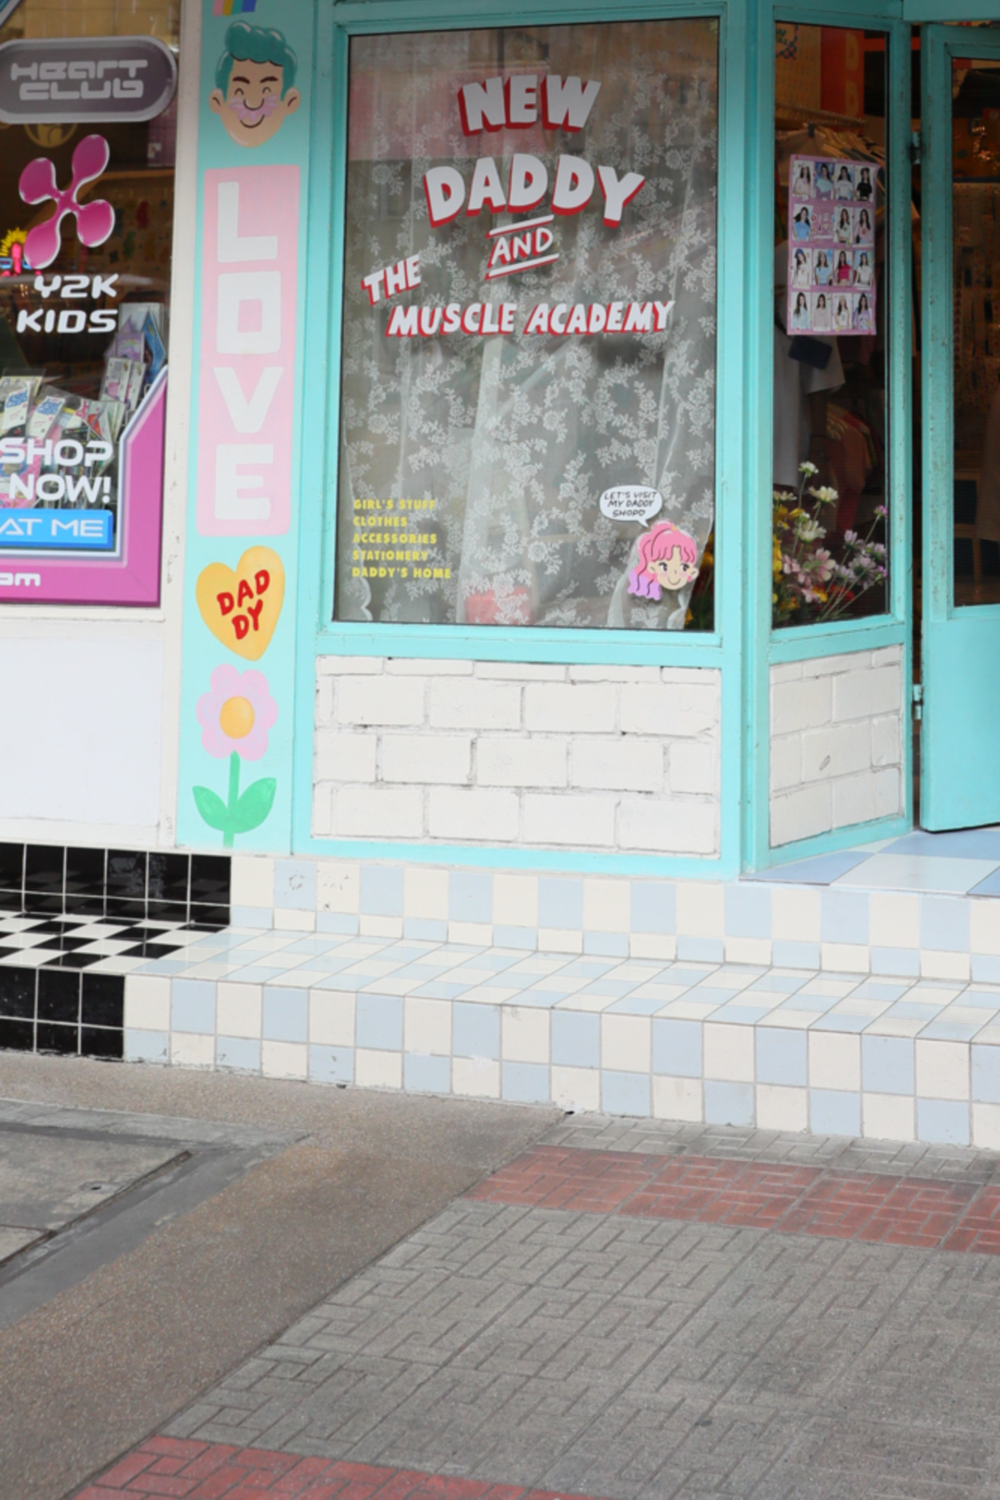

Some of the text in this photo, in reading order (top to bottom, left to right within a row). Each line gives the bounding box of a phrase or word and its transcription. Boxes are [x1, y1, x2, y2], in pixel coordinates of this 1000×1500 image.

[457, 74, 601, 136] NEW
[423, 153, 646, 227] DADDY
[490, 226, 555, 269] AND
[34, 273, 119, 299] Y2K
[361, 254, 422, 305] THE
[16, 308, 118, 333] KIDS
[385, 300, 676, 338] MUSCLE ACADEMY
[213, 180, 285, 522] LOVE
[0, 437, 114, 467] SHOP
[9, 472, 112, 503] NOW!
[604, 491, 631, 500] LET'S
[353, 499, 435, 510] GIRL'S STUFF
[51, 518, 104, 537] ME
[353, 516, 408, 527] CLOTHES
[353, 533, 437, 544] ACCESSORIES
[352, 550, 429, 561] STATIONERY
[352, 567, 452, 579] DADDY'S HOME
[217, 569, 271, 616] DAD
[232, 599, 264, 641] DY
